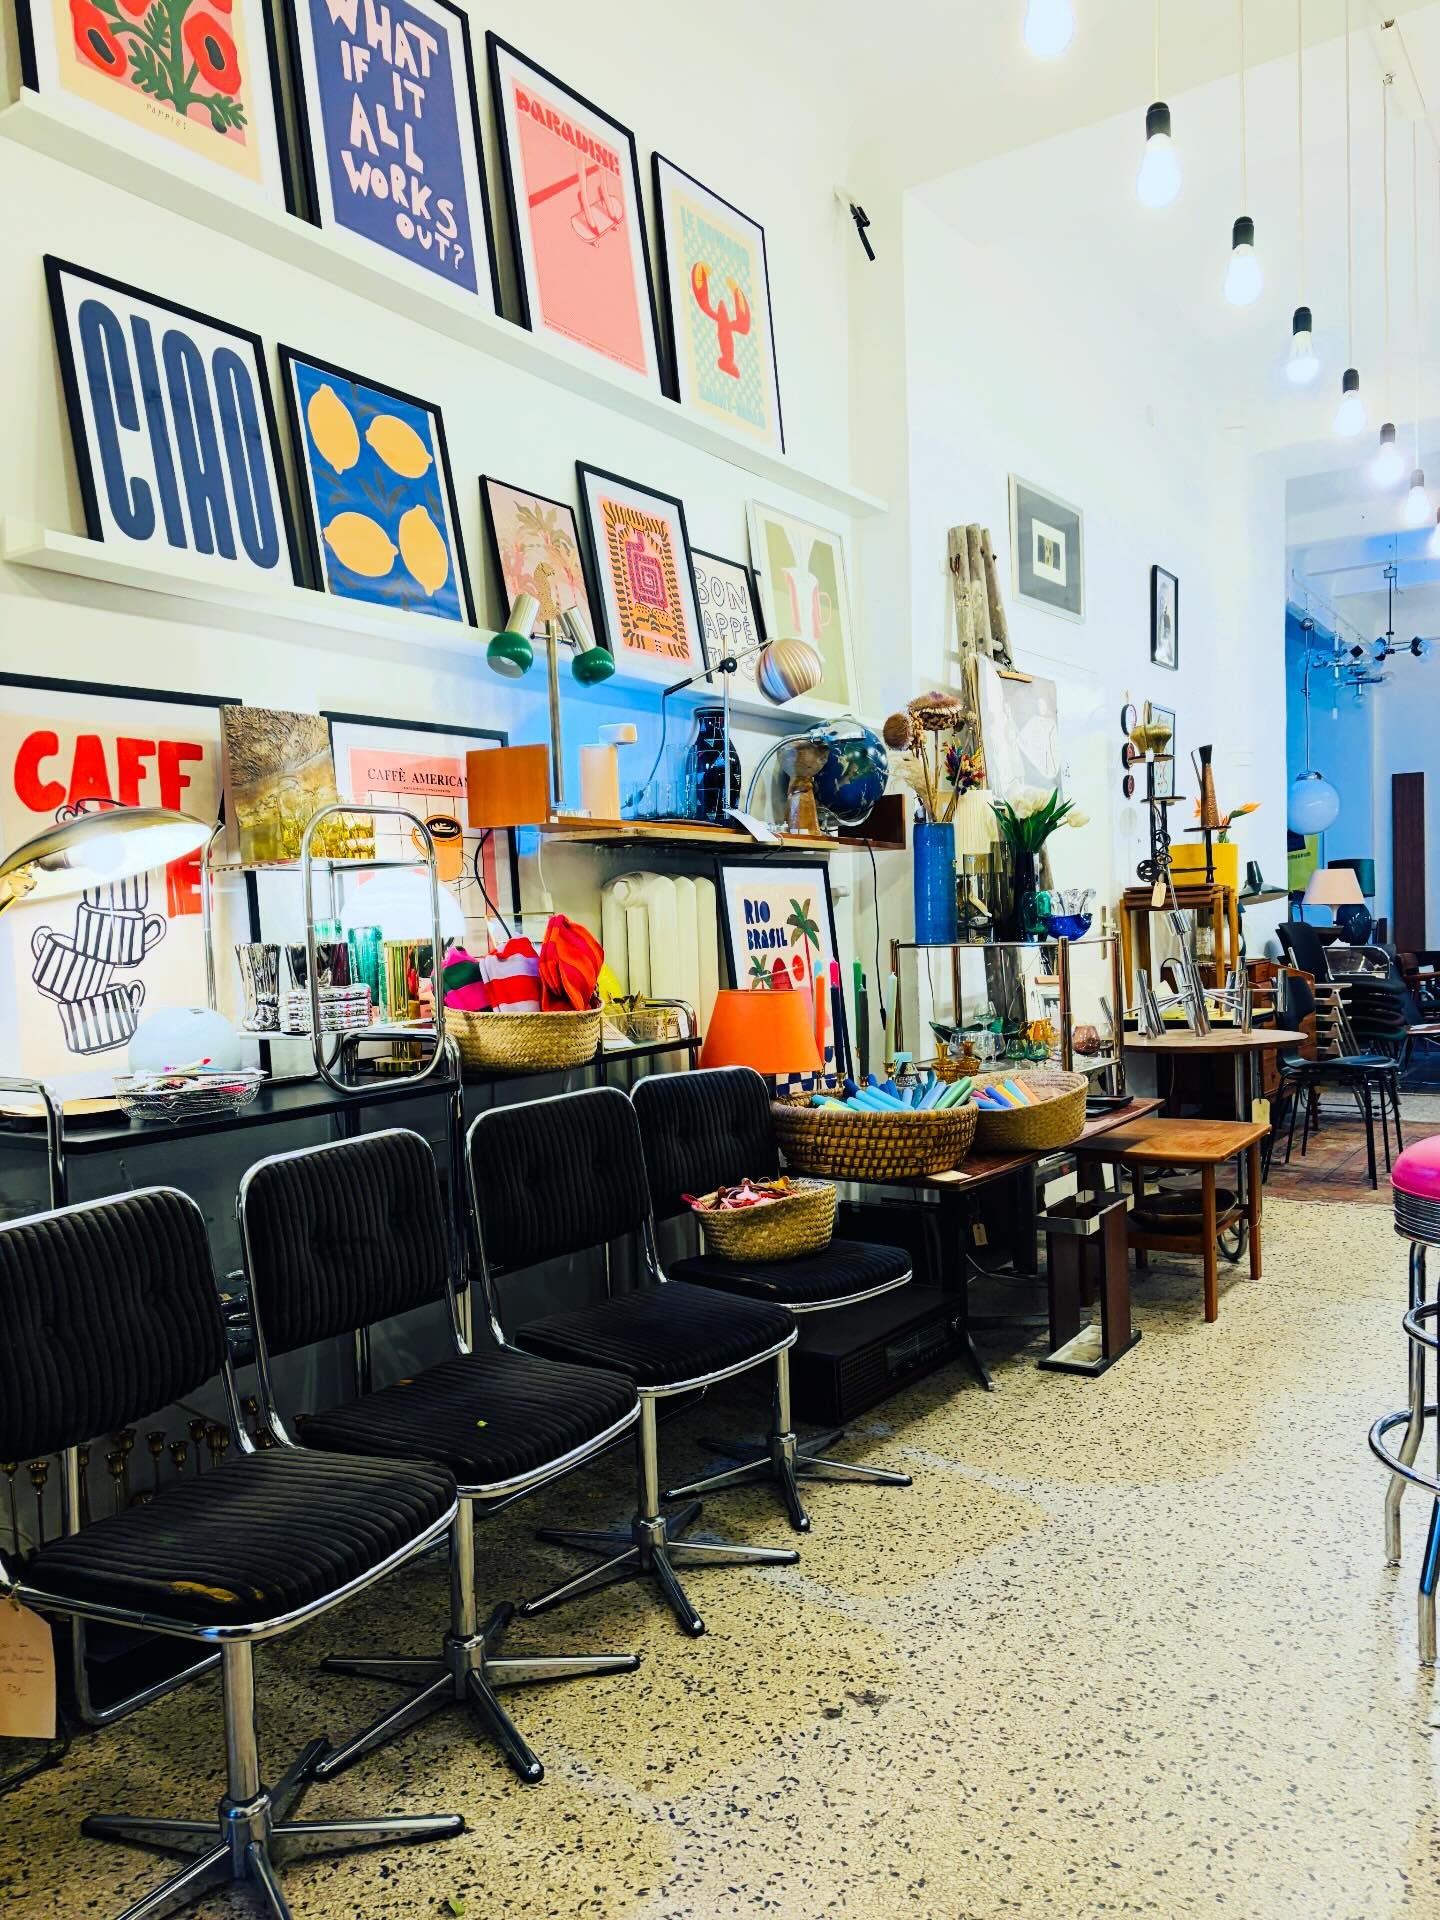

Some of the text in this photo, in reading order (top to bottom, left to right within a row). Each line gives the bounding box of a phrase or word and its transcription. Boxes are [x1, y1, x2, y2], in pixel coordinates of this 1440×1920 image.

[325, 0, 439, 78] WHAT
[340, 40, 425, 119] IF IT
[350, 92, 424, 174] ALL
[514, 87, 620, 176] PARADISE
[340, 150, 458, 239] WORKS
[395, 212, 465, 270] OUT?
[78, 299, 280, 570] CIAO
[693, 566, 748, 613] BON
[14, 730, 203, 813] CAFF
[367, 767, 406, 783] CAFFÈ
[743, 898, 771, 925] RIO
[746, 927, 788, 950] BRASIL
